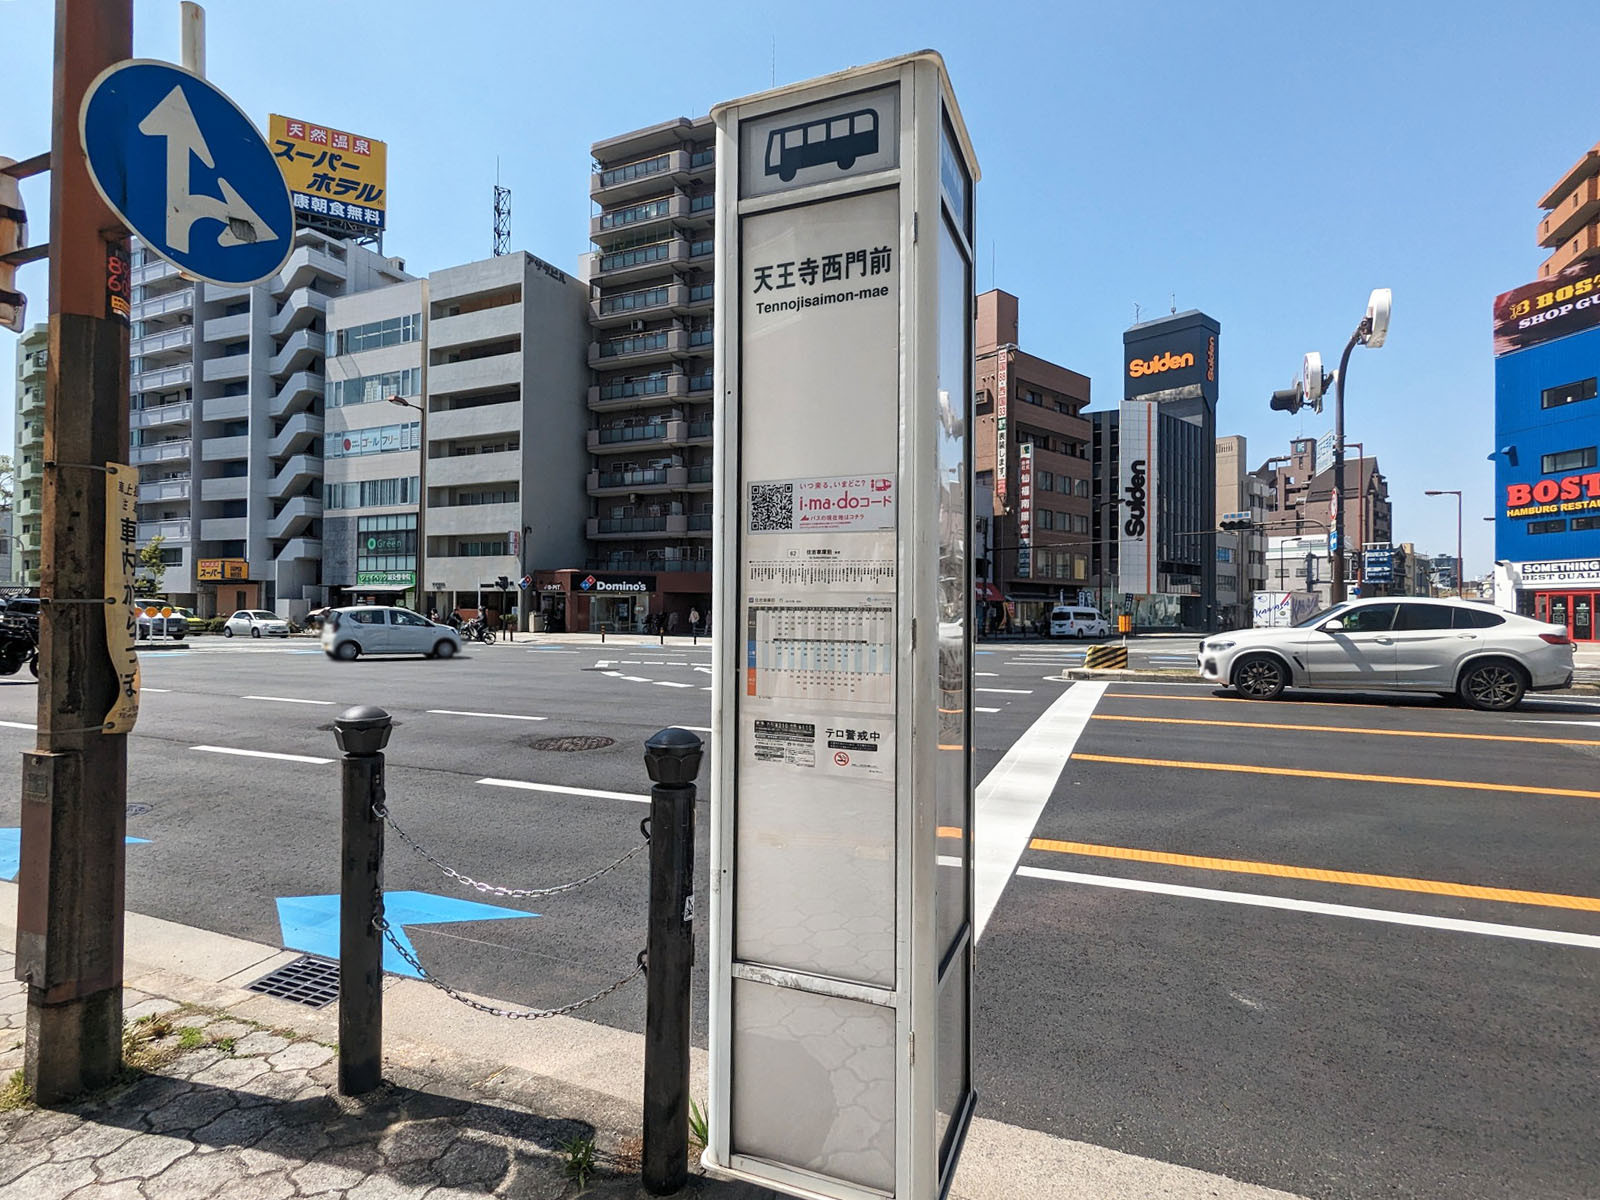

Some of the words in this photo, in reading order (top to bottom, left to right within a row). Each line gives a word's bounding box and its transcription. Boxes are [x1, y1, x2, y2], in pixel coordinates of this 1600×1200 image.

[288, 123, 370, 155] 天然温泉
[274, 139, 360, 172] スーパー
[306, 173, 384, 202] ホテル
[293, 193, 380, 225] 康朝食無料
[753, 245, 892, 294] 天王寺西門前
[756, 286, 889, 314] Tennojisaimon-mae
[1519, 303, 1574, 329] SHOP
[1129, 351, 1194, 378] Suiden
[1207, 336, 1215, 382] Suiden
[1124, 460, 1146, 537] Suiden
[1507, 505, 1558, 517] HAMBURG
[376, 539, 402, 549] Green
[200, 569, 223, 577] スーパー
[1522, 573, 1555, 581] BEST
[1523, 561, 1600, 573] SOMETHING
[596, 581, 647, 592] Domino's
[825, 728, 881, 741] テロ警戒中
